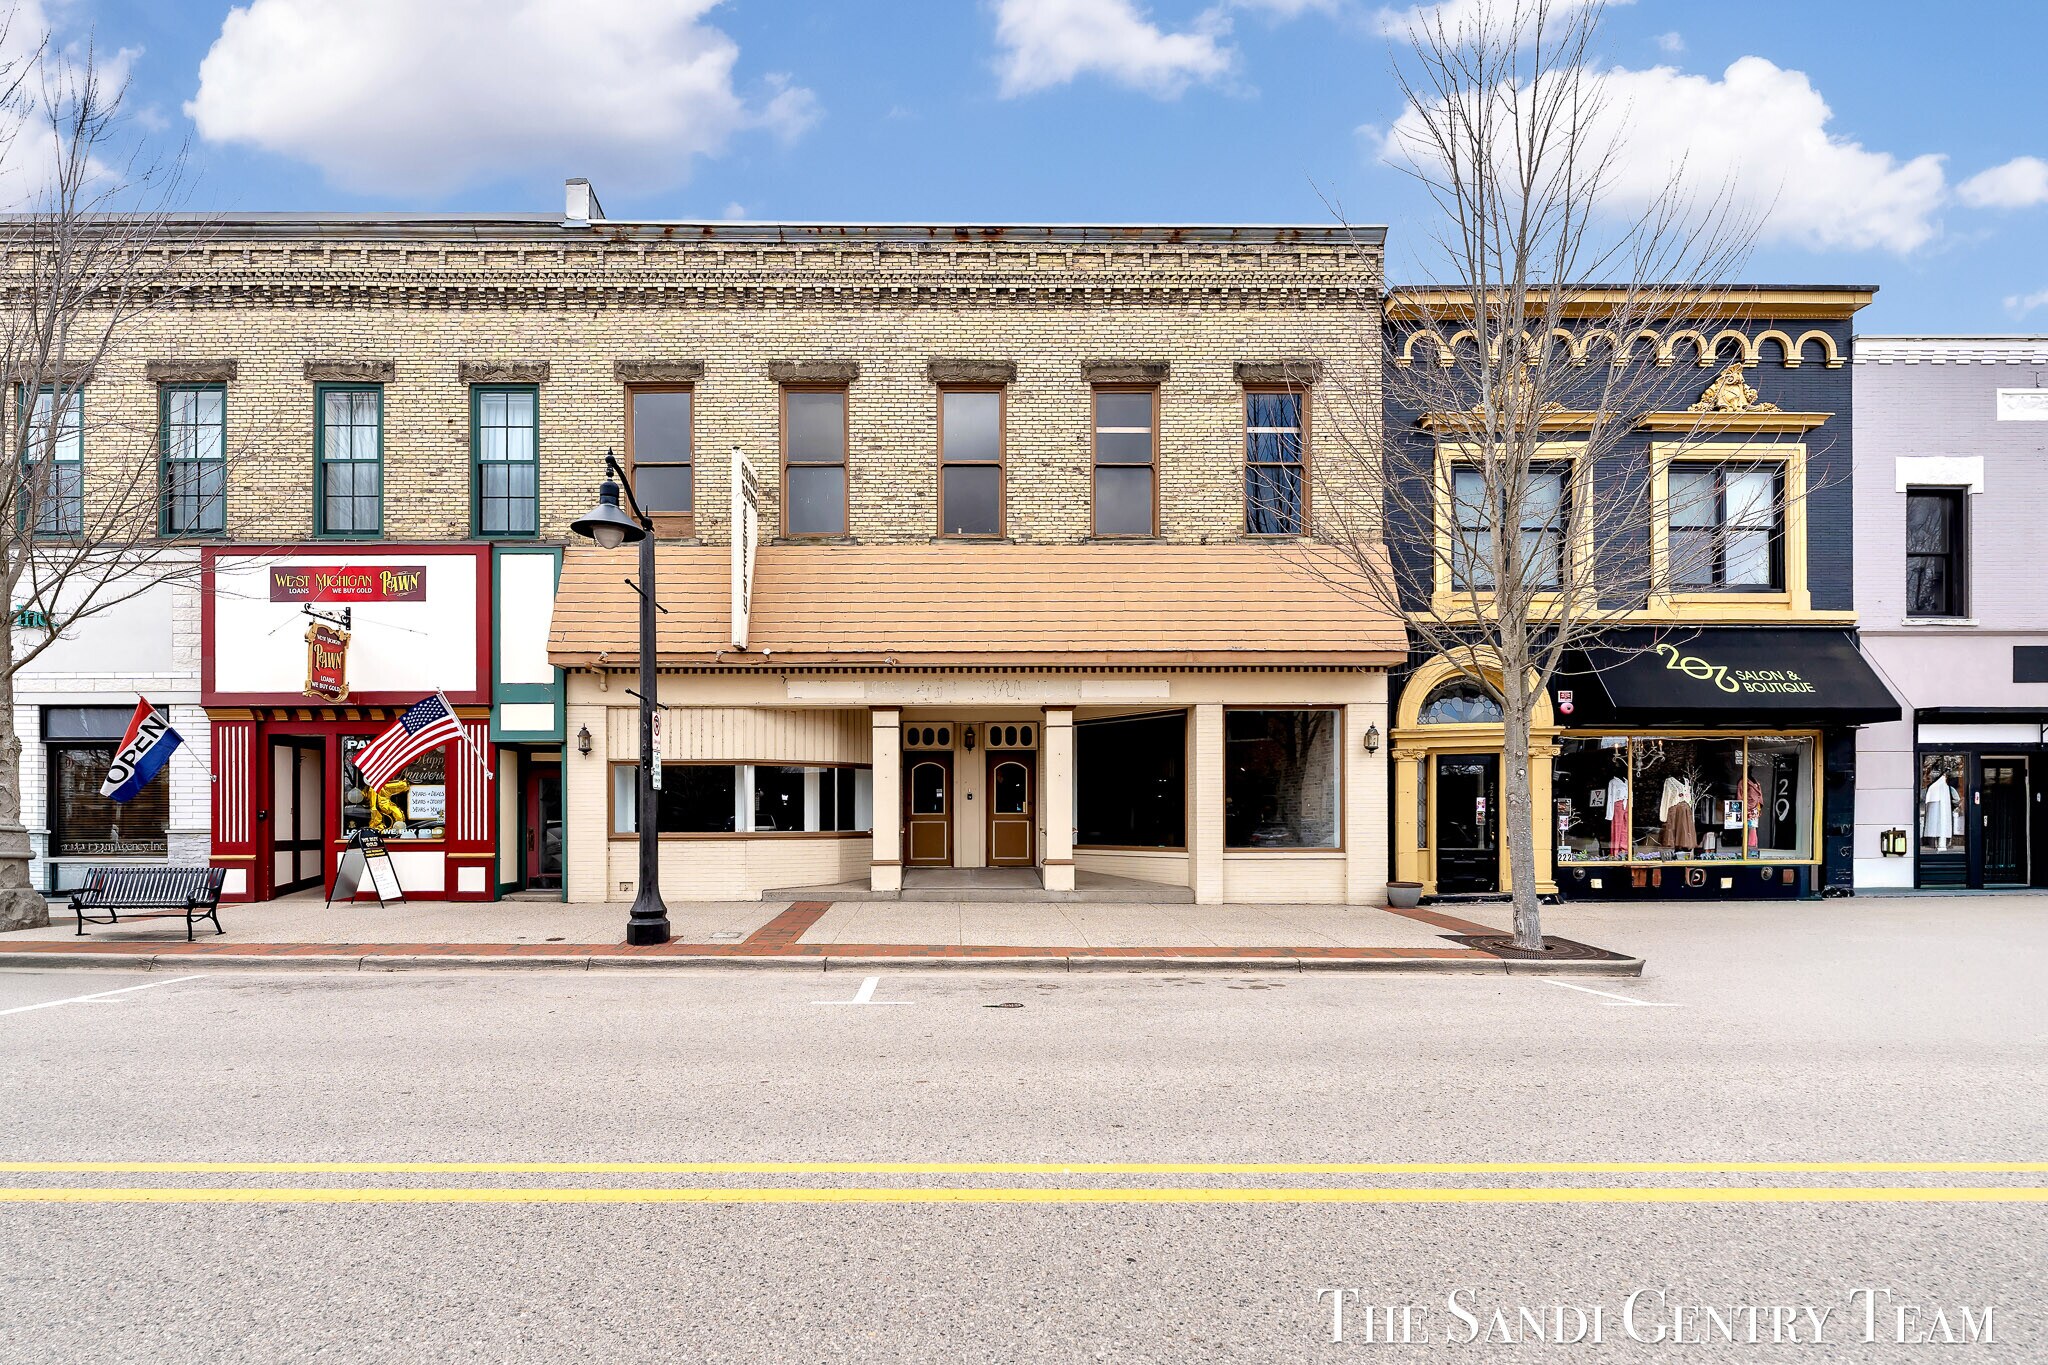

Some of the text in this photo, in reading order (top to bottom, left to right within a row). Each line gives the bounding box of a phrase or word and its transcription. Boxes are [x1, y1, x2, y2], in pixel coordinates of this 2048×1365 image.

[275, 571, 420, 596] WEST MICHIGAN PAWN
[314, 643, 344, 671] PAWN
[320, 675, 336, 684] LOANS
[1735, 670, 1801, 681] SALON &
[328, 684, 341, 692] GOLD
[1742, 682, 1816, 693] BOUTIQUE
[106, 715, 167, 784] OPEN
[1558, 853, 1572, 862] 222
